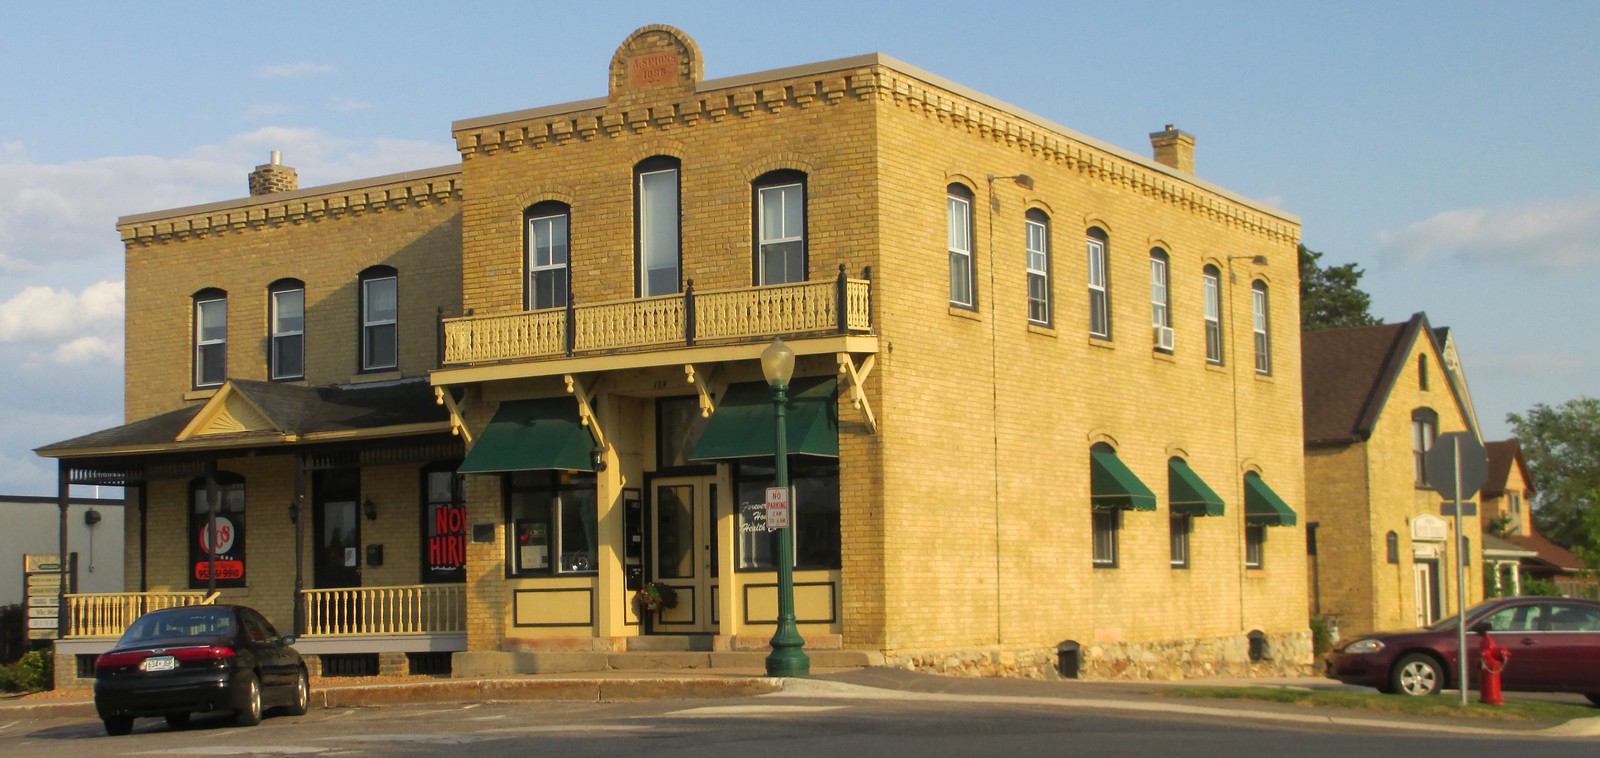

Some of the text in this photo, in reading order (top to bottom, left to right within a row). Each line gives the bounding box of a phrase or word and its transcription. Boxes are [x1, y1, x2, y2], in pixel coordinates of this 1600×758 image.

[772, 492, 781, 500] NO
[767, 500, 787, 509] PARKING
[430, 535, 465, 567] HIRI
